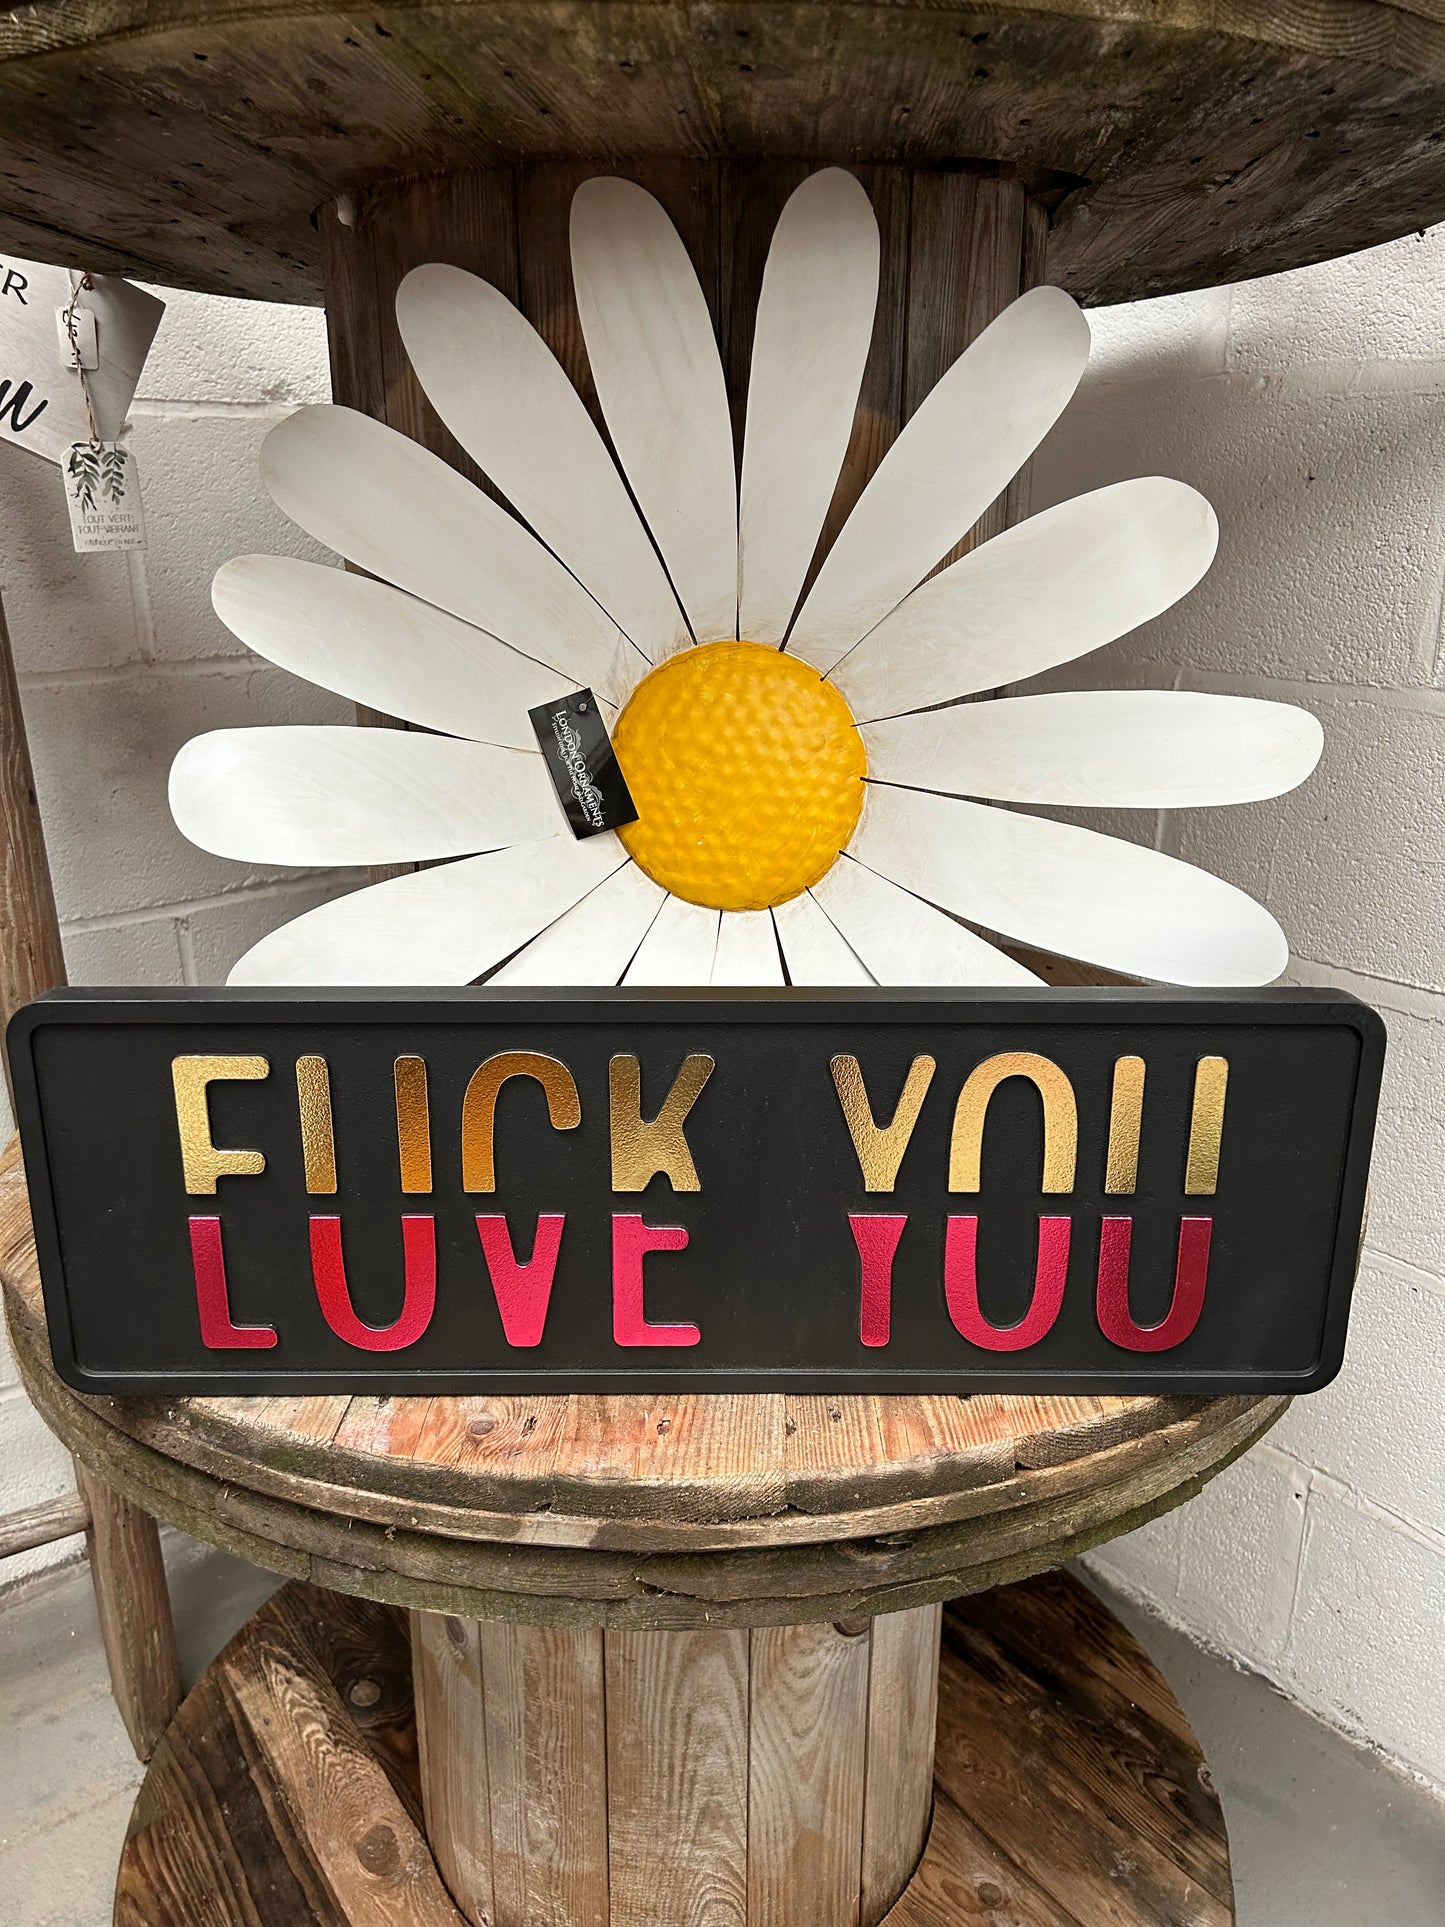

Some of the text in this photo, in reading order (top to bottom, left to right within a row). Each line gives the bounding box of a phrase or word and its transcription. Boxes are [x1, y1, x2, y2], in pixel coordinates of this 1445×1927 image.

[556, 709, 605, 828] LONDON ORNAMENTS
[829, 1051, 1229, 1196] YOU
[188, 1213, 1213, 1353] LOVE YOU
